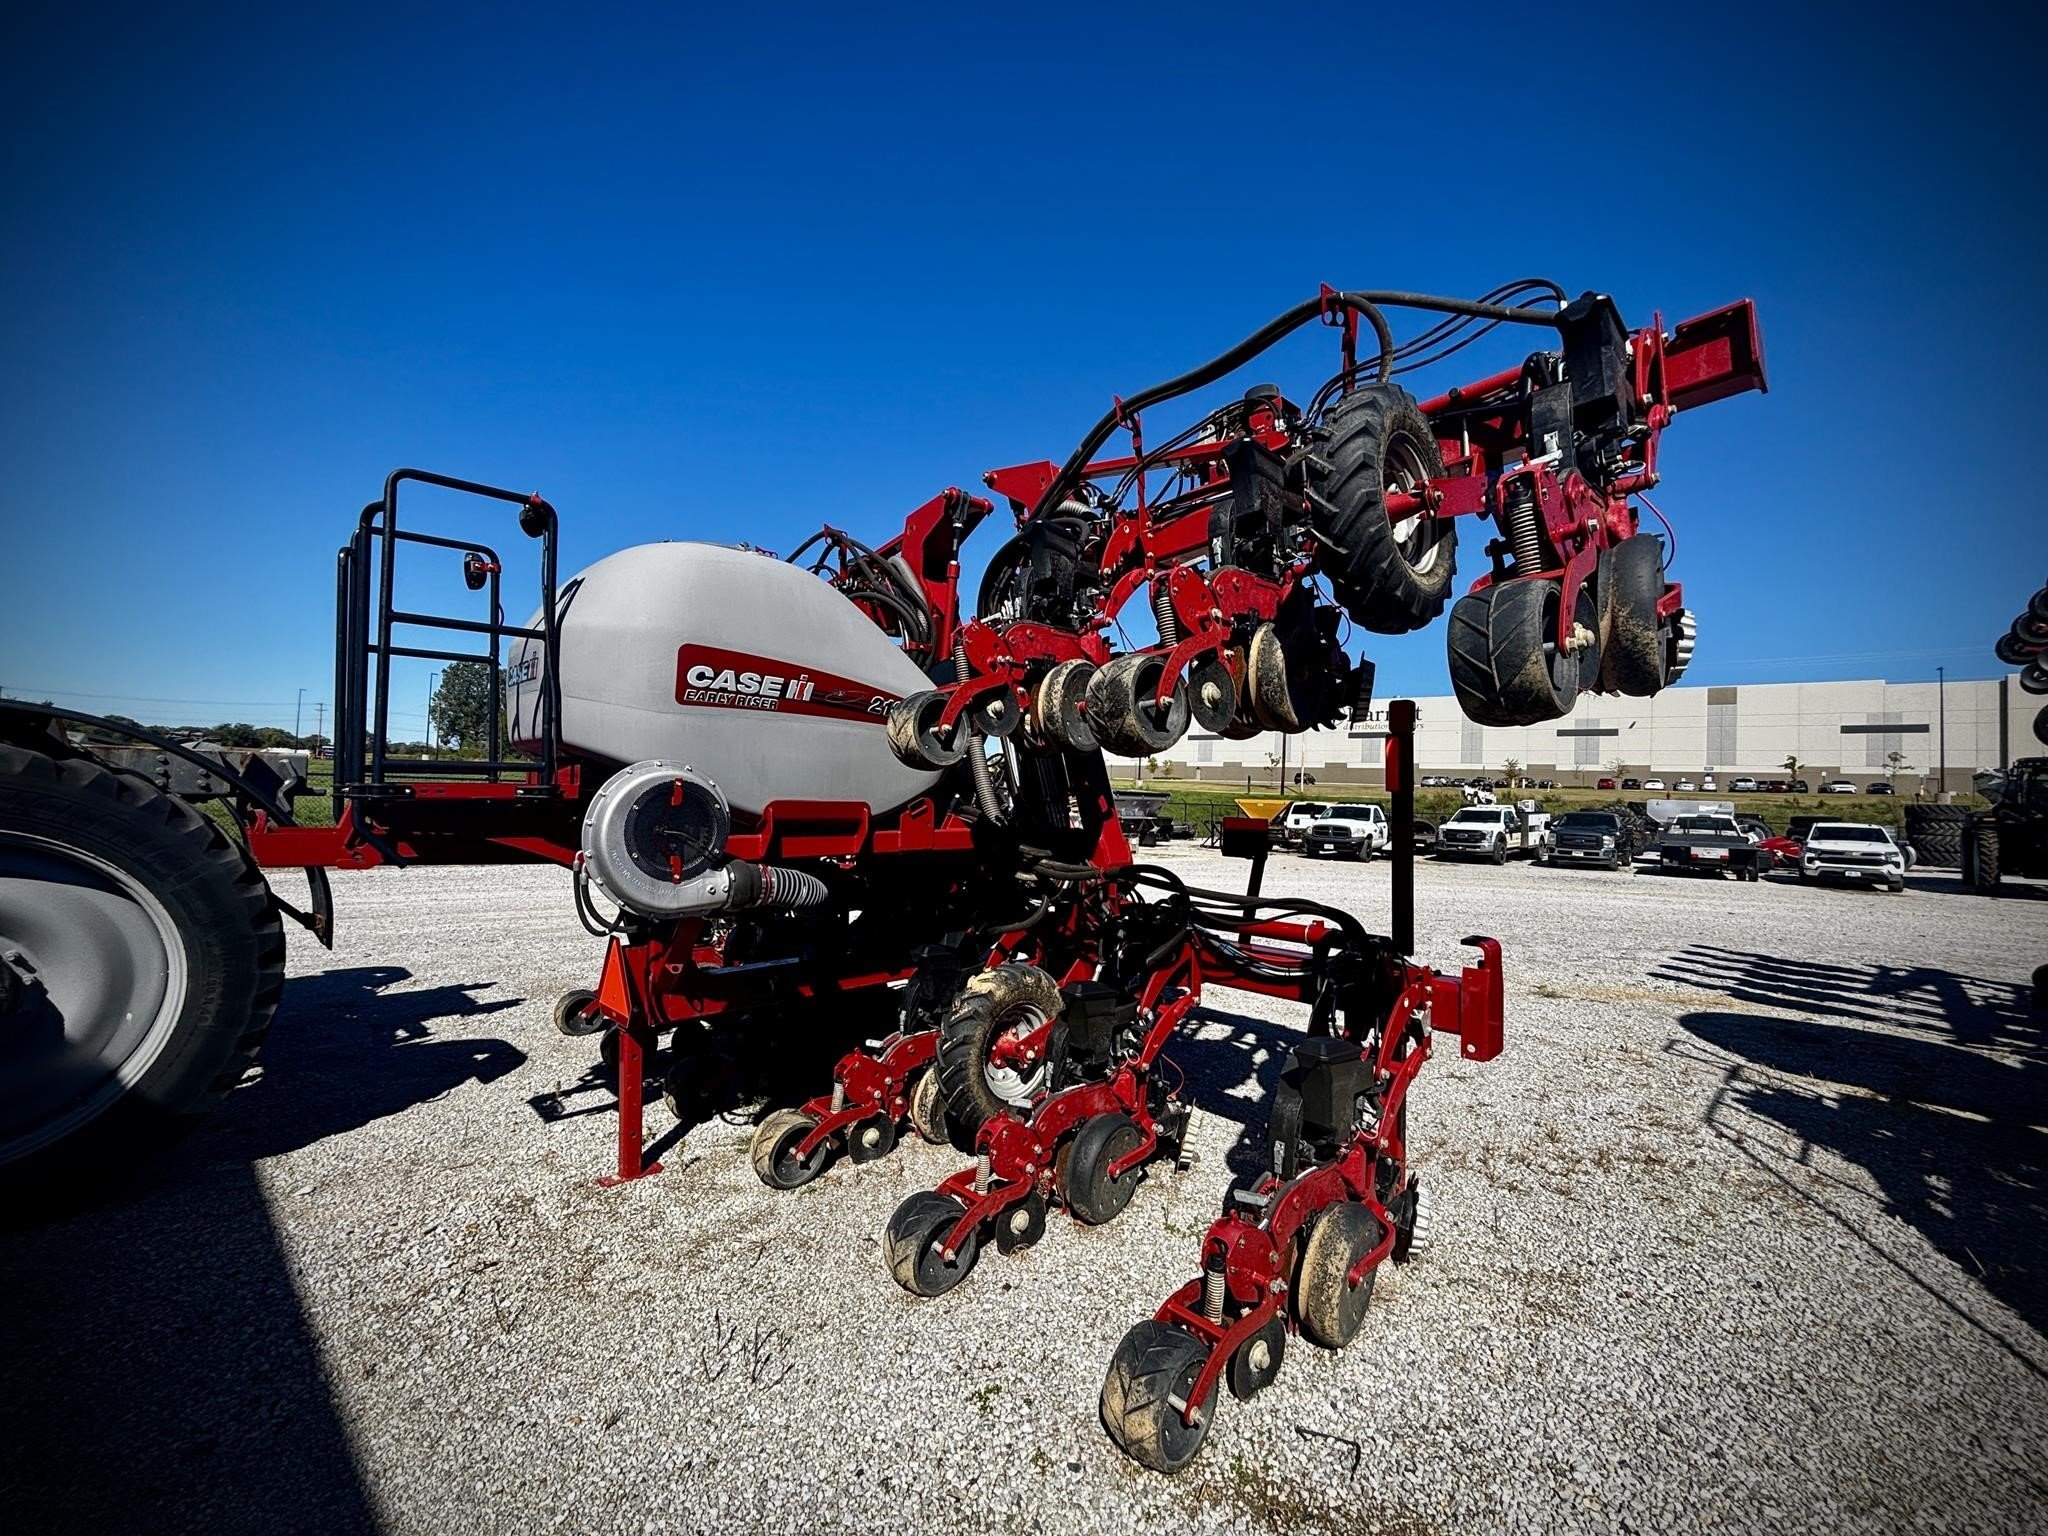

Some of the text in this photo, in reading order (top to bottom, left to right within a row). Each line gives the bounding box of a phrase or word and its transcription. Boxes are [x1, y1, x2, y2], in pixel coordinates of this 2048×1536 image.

[508, 662, 528, 687] CASE
[686, 665, 785, 698] CASE
[683, 688, 779, 711] EARLY RISER
